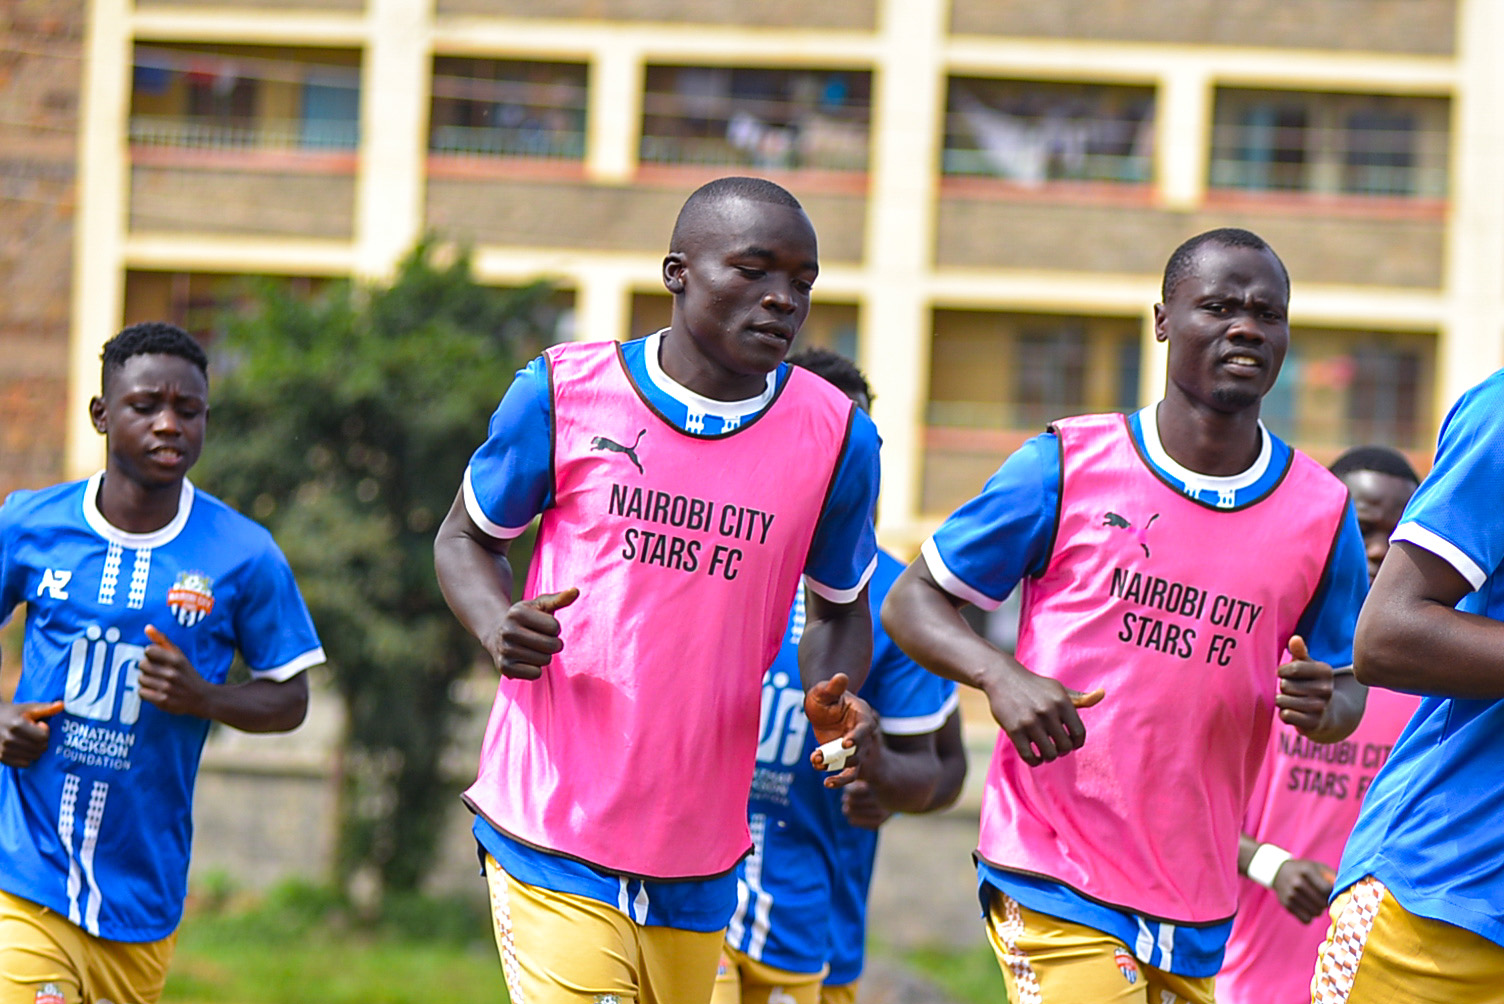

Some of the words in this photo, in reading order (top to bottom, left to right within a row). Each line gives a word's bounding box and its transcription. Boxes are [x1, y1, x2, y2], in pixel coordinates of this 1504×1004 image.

[609, 483, 714, 533] NAIROBI
[718, 504, 775, 545] CITY
[622, 528, 702, 573] STARS
[708, 545, 743, 581] FC
[37, 568, 72, 600] AZ
[1110, 568, 1208, 620] NAIROBI
[1210, 595, 1263, 634] CITY
[1118, 612, 1197, 659] STARS
[1206, 634, 1237, 667] FC
[61, 718, 135, 746] JONATHAN
[63, 733, 129, 759] JACKSON
[55, 745, 132, 771] FOUNDATION
[1362, 742, 1393, 769] CIT
[1287, 766, 1350, 800] STARS
